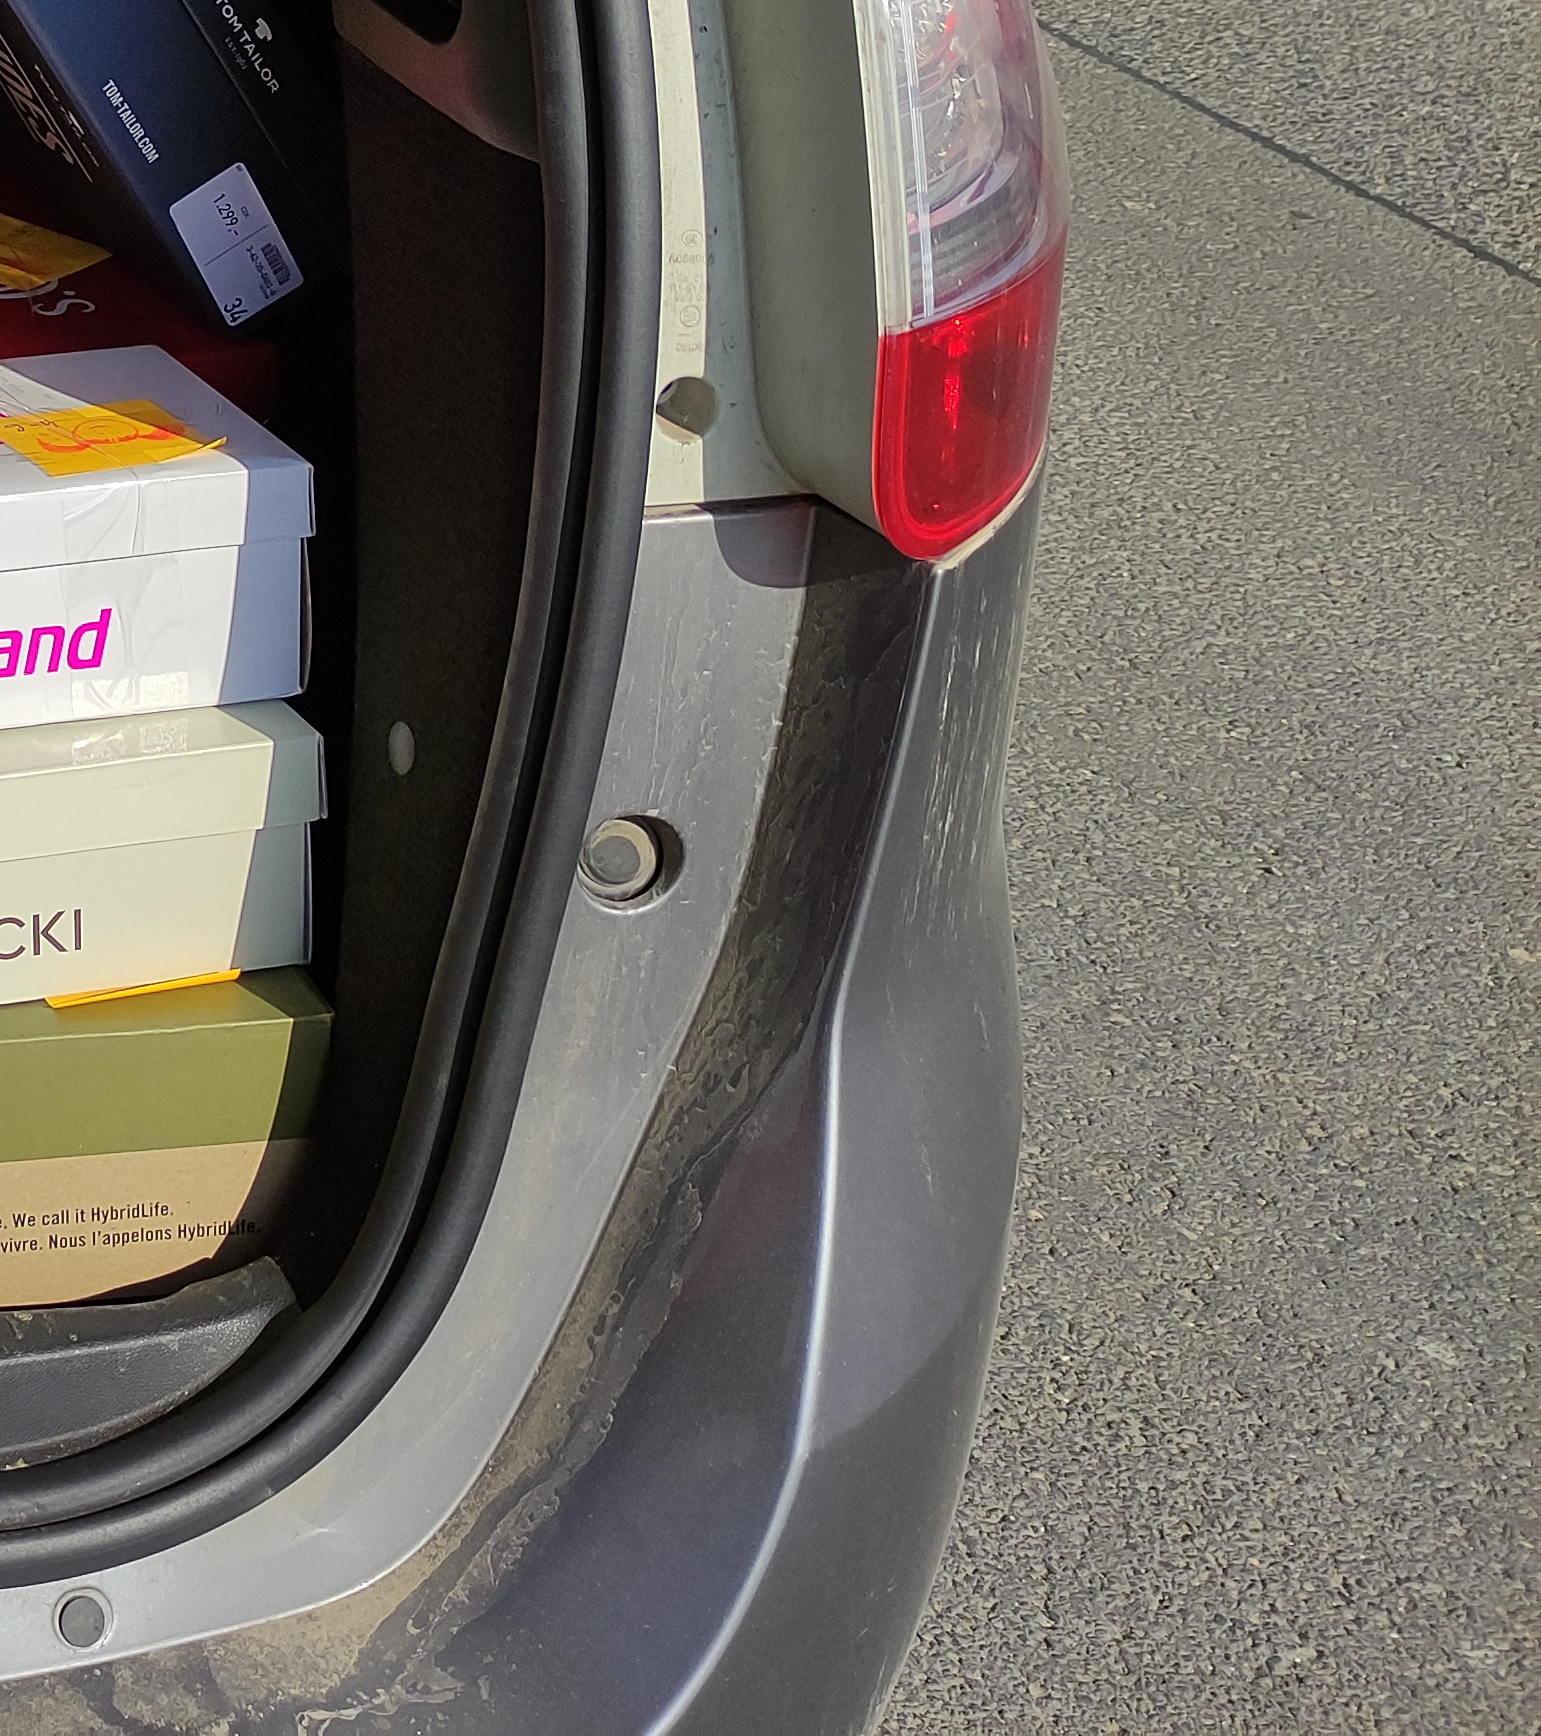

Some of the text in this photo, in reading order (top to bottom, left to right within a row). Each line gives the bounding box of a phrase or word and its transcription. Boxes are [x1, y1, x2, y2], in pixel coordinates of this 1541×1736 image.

[239, 30, 279, 94] TAILOR
[101, 79, 159, 164] TOM-TAILOR.COM
[223, 297, 248, 324] 34
[12, 1212, 37, 1229] We
[42, 1209, 70, 1226] call
[75, 1207, 86, 1224] it
[91, 1200, 175, 1224] HybridLife.
[0, 1236, 44, 1253] vivre.
[48, 1233, 87, 1250] Nous
[92, 1226, 173, 1248] l'appelons
[178, 1218, 261, 1243] HybridLife.
